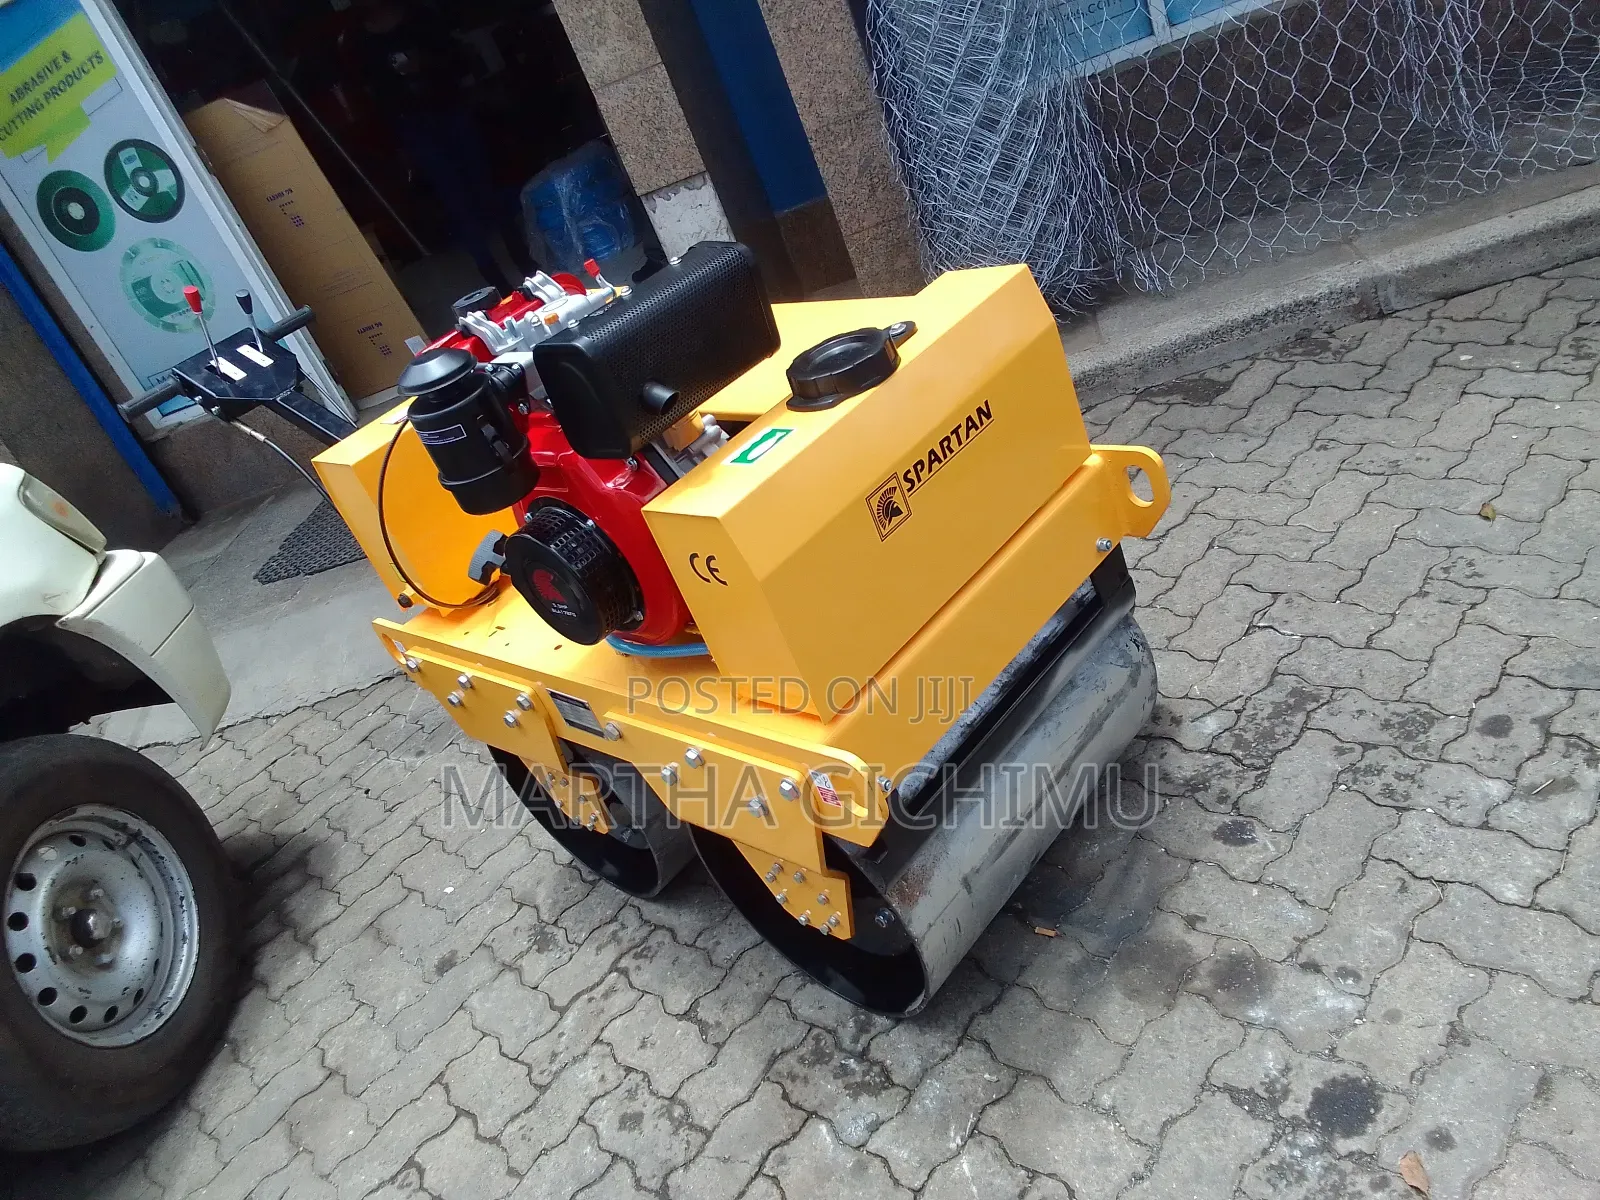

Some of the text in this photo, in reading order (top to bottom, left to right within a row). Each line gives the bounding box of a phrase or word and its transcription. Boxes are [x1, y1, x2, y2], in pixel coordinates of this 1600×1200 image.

[0, 50, 103, 141] CUTTING PRODUCTS
[9, 57, 62, 106] ABRASIVE
[902, 399, 993, 493] SPARTAN
[689, 553, 728, 586] CE
